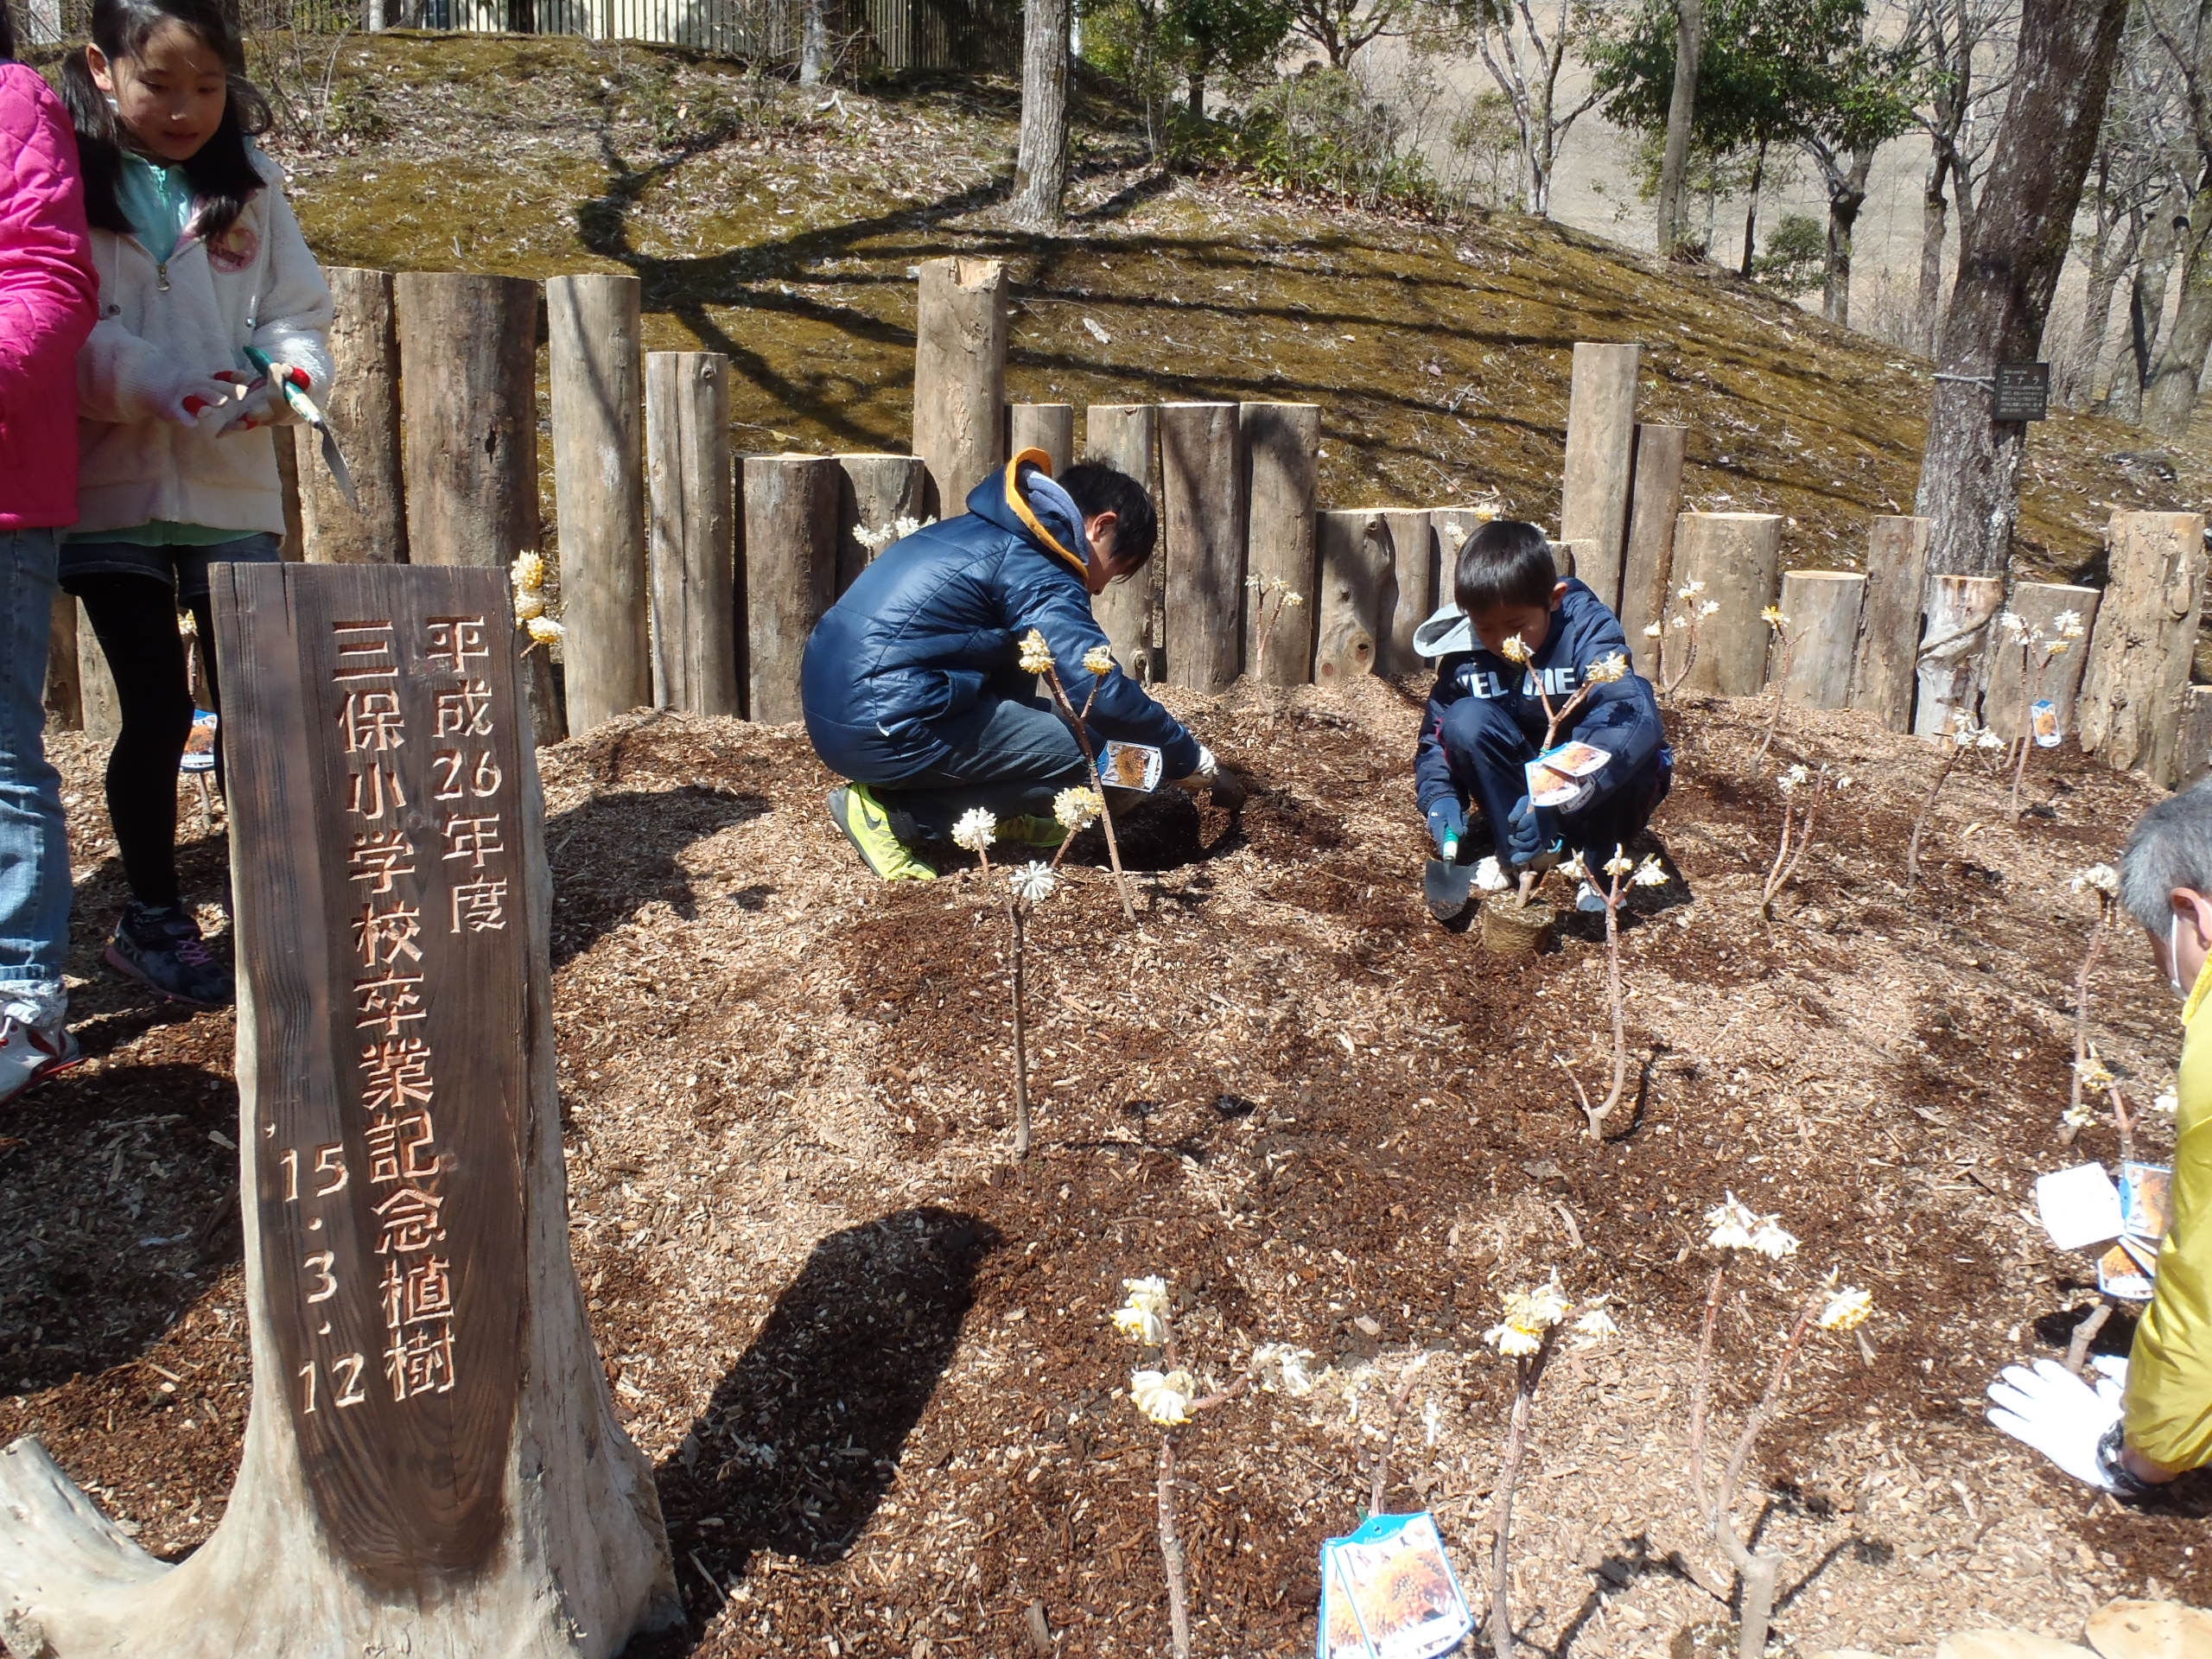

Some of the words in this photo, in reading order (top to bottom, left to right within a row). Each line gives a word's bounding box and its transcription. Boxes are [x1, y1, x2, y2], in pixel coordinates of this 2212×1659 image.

[2003, 375, 2040, 385] コナラ
[426, 615, 507, 934] 平成26年度
[332, 620, 456, 1403] 三保小学校卒業記念植樹
